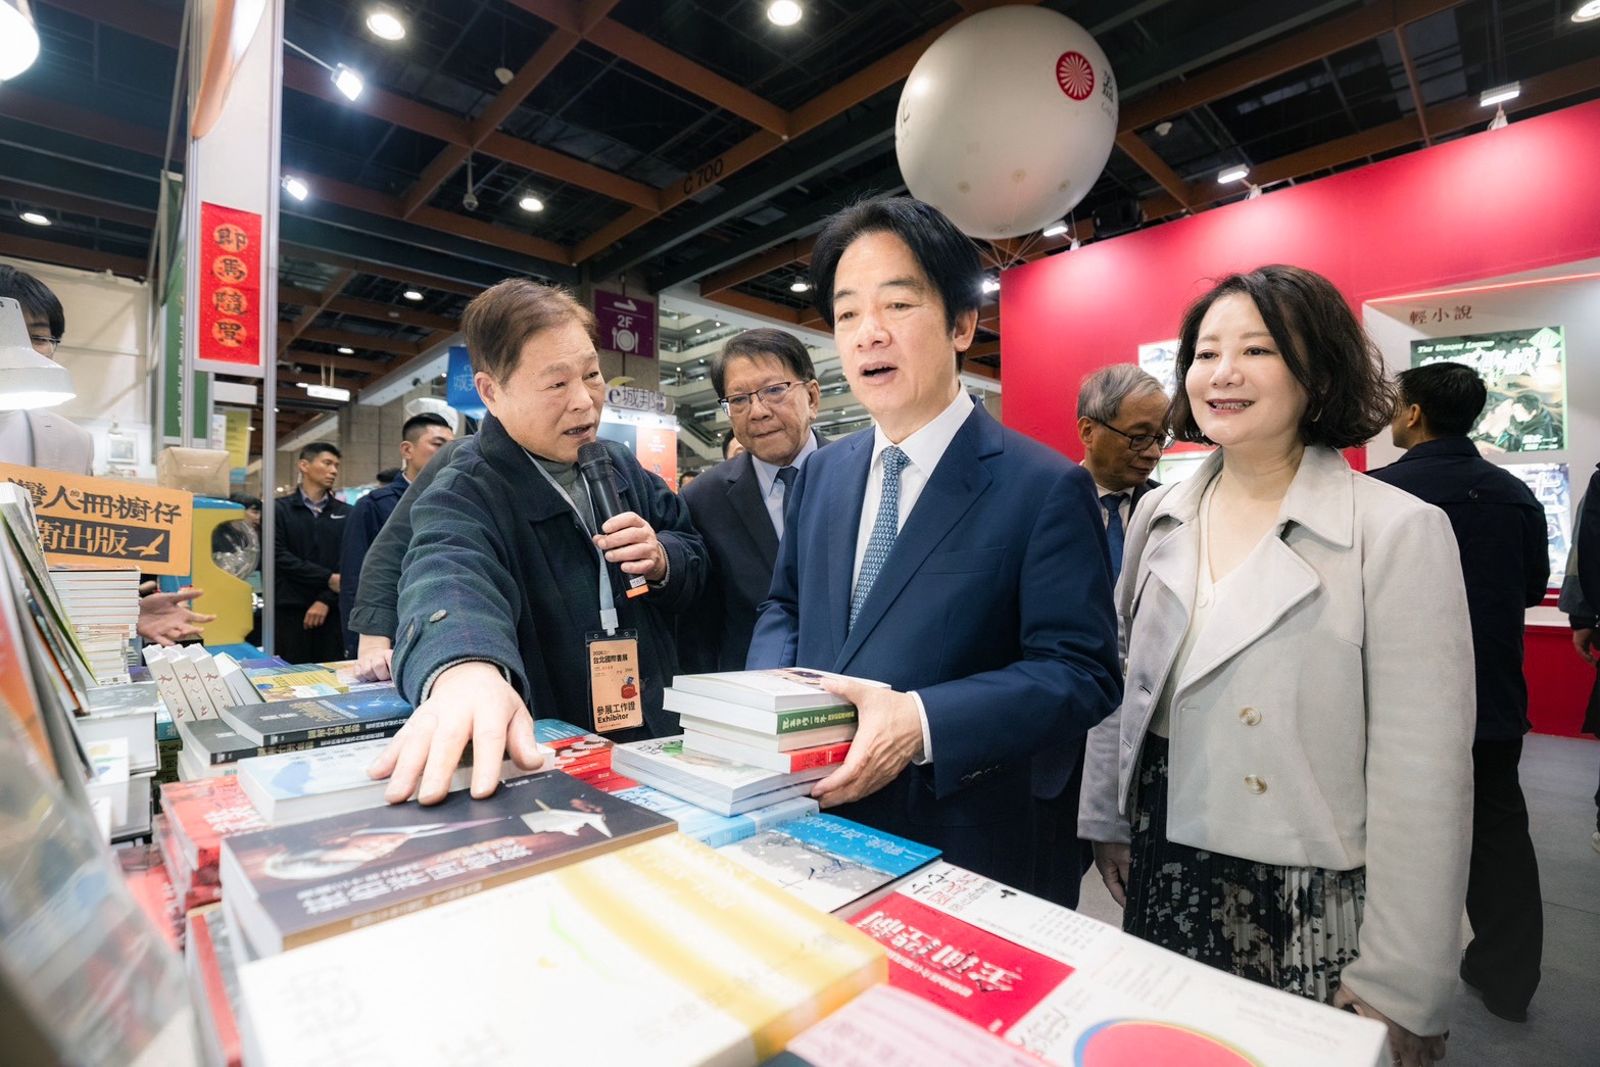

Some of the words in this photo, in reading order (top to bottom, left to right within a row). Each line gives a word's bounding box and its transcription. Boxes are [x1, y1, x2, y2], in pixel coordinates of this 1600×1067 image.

[684, 176, 693, 194] C
[696, 158, 723, 187] 700
[617, 315, 633, 328] 2F
[1410, 305, 1472, 325] 輕小說
[597, 701, 635, 715] 參展工作證
[597, 713, 629, 724] Exhibitor
